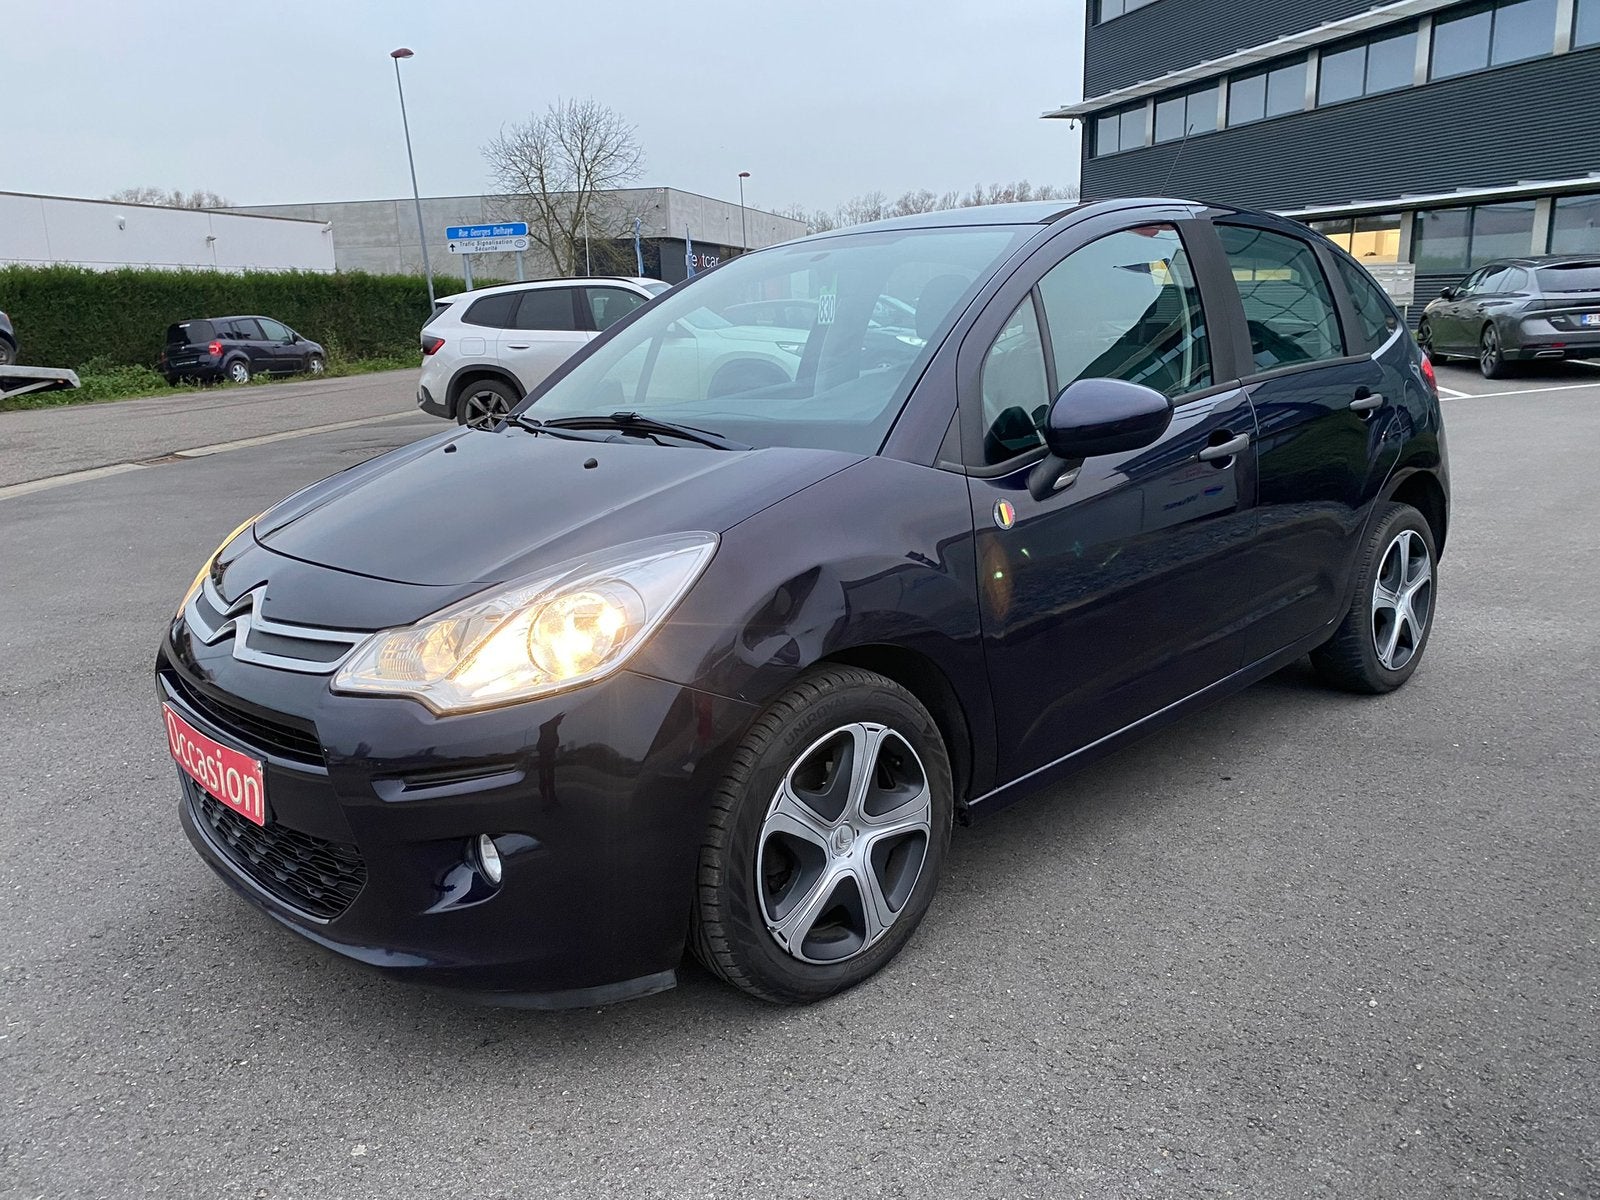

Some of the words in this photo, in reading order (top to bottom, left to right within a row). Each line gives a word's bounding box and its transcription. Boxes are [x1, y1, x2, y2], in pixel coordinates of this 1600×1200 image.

[458, 228, 469, 237] Rue
[470, 228, 491, 238] Georges
[820, 295, 835, 322] 830
[167, 712, 261, 818] Occasion
